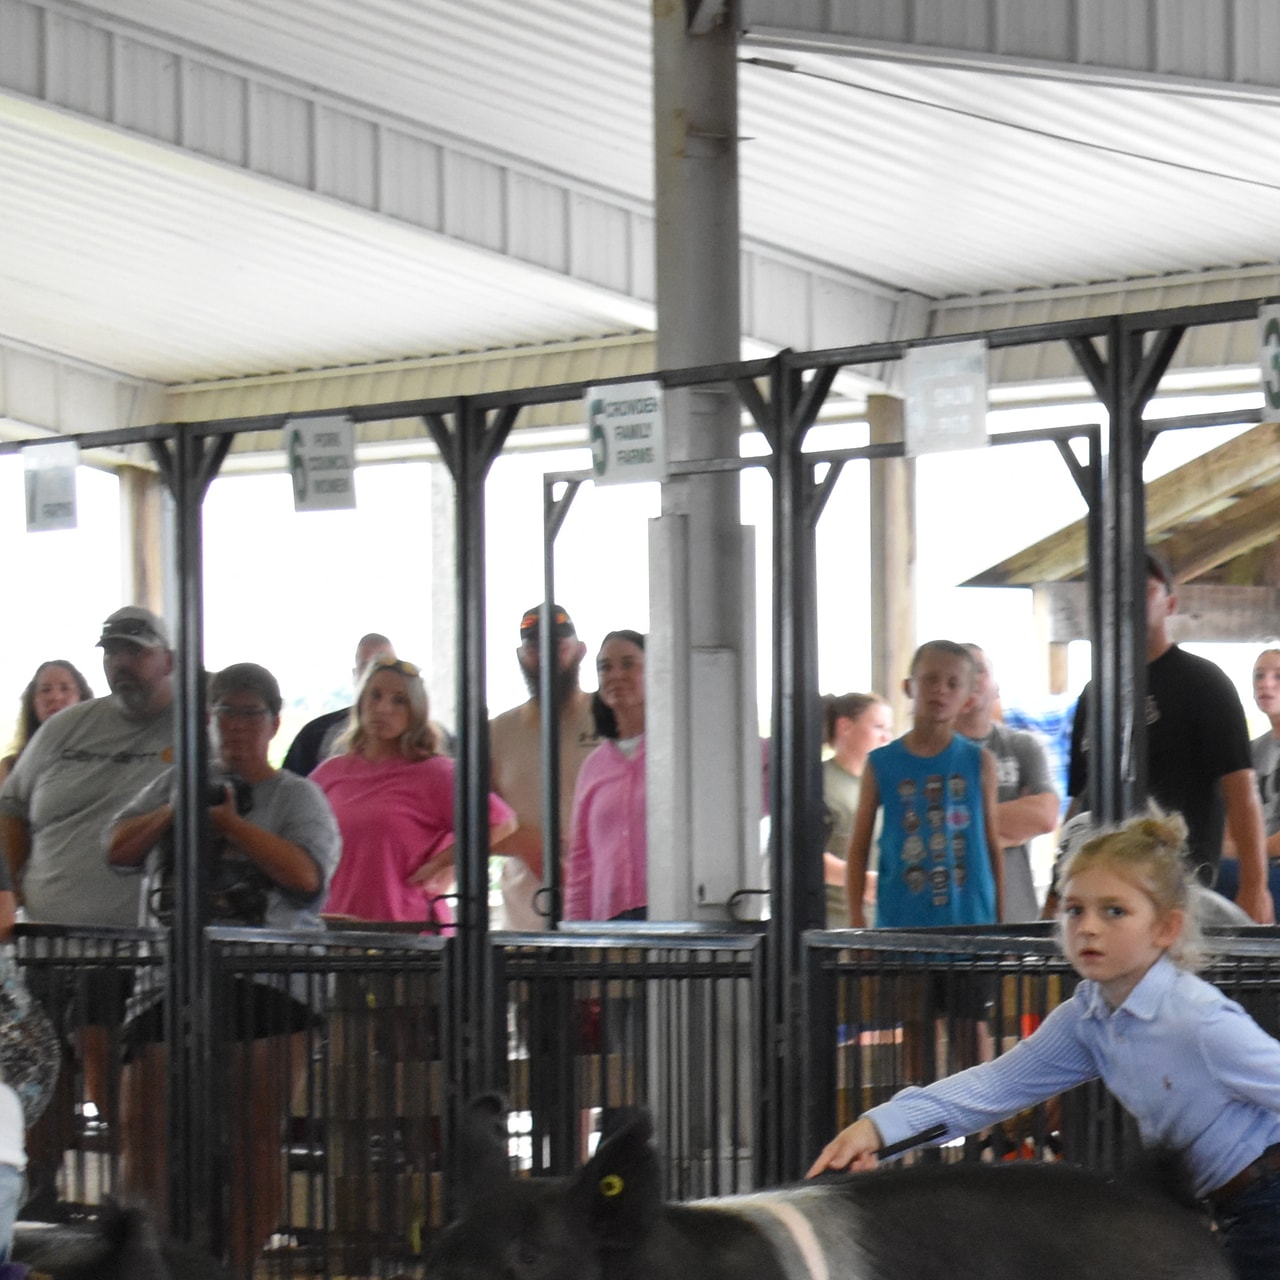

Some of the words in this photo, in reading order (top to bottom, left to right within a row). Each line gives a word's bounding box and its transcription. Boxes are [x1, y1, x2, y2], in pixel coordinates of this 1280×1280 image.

[590, 399, 608, 475] 5
[614, 422, 653, 441] FAMILY
[290, 429, 306, 502] 6
[616, 447, 655, 465] FARMS
